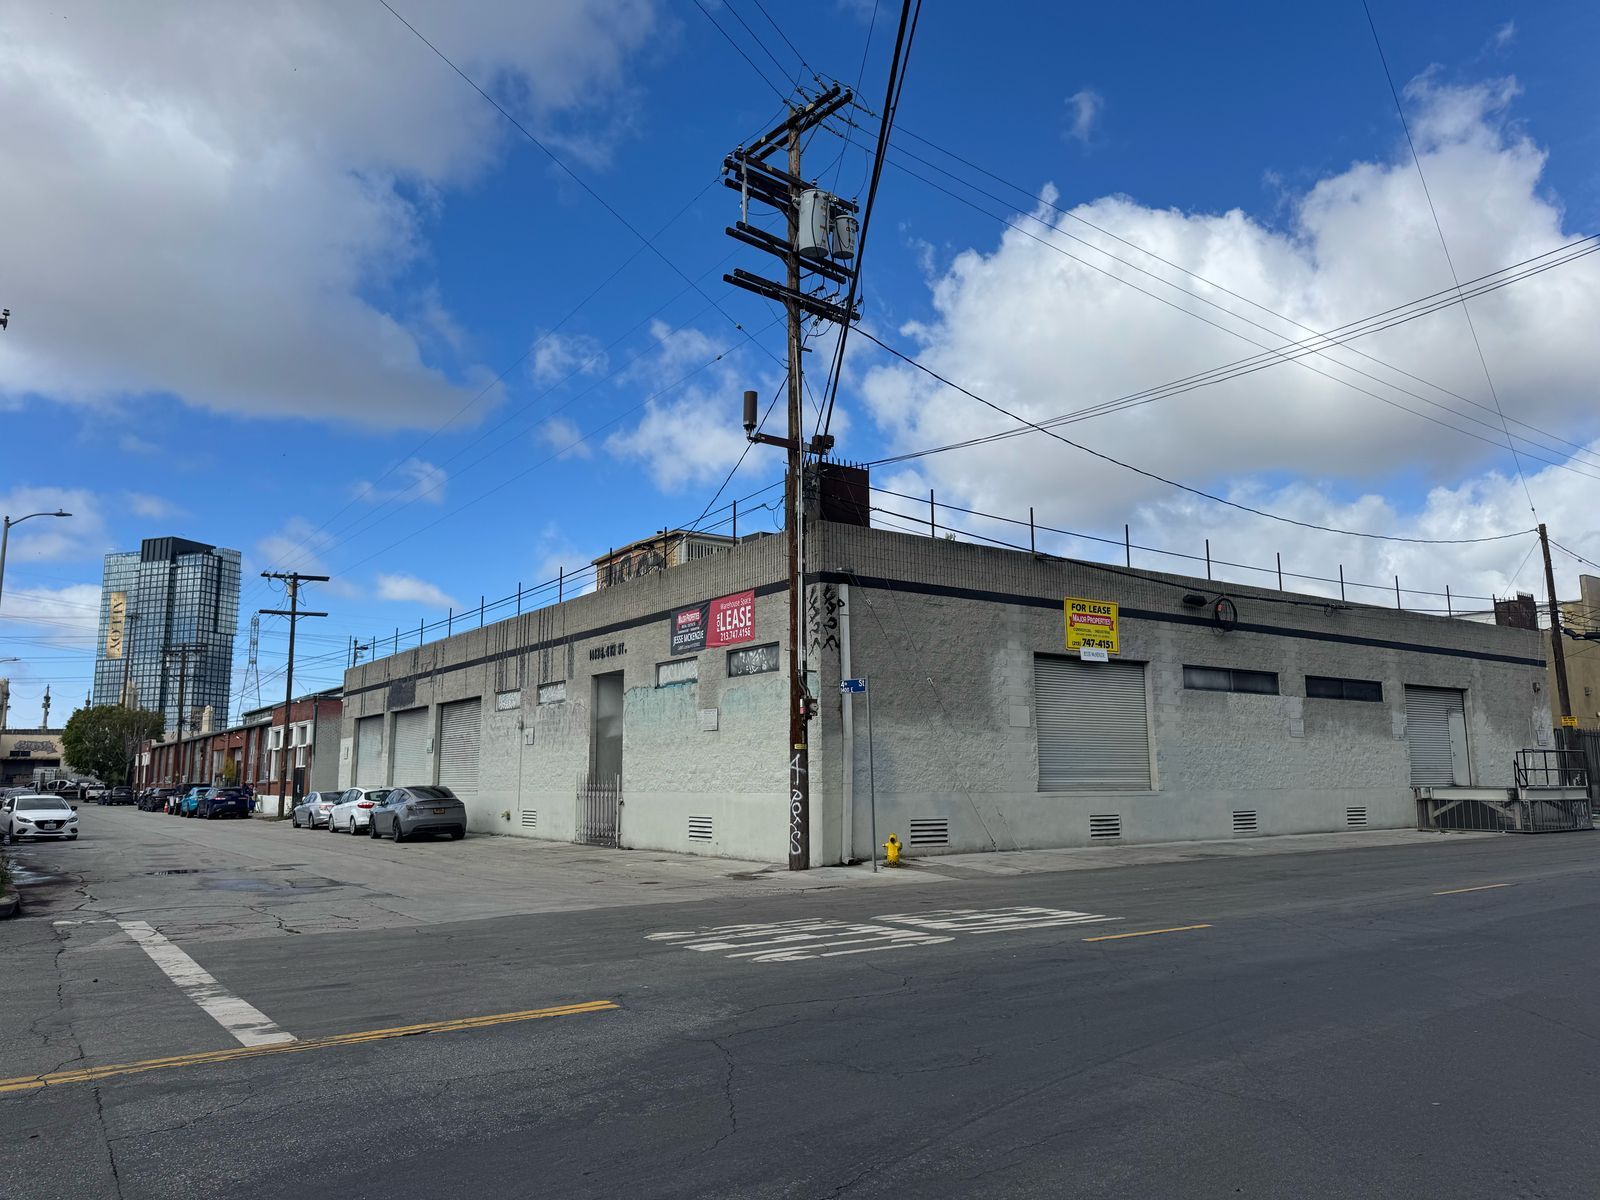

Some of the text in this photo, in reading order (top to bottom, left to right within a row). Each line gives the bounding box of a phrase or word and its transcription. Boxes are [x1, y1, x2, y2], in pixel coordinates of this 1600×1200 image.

[720, 597, 752, 610] Warehouse Space
[1071, 603, 1111, 614] FOR LEASE
[720, 605, 752, 631] LEASE
[673, 635, 684, 647] JESSE
[1082, 638, 1114, 649] 747-4151
[858, 679, 865, 687] St
